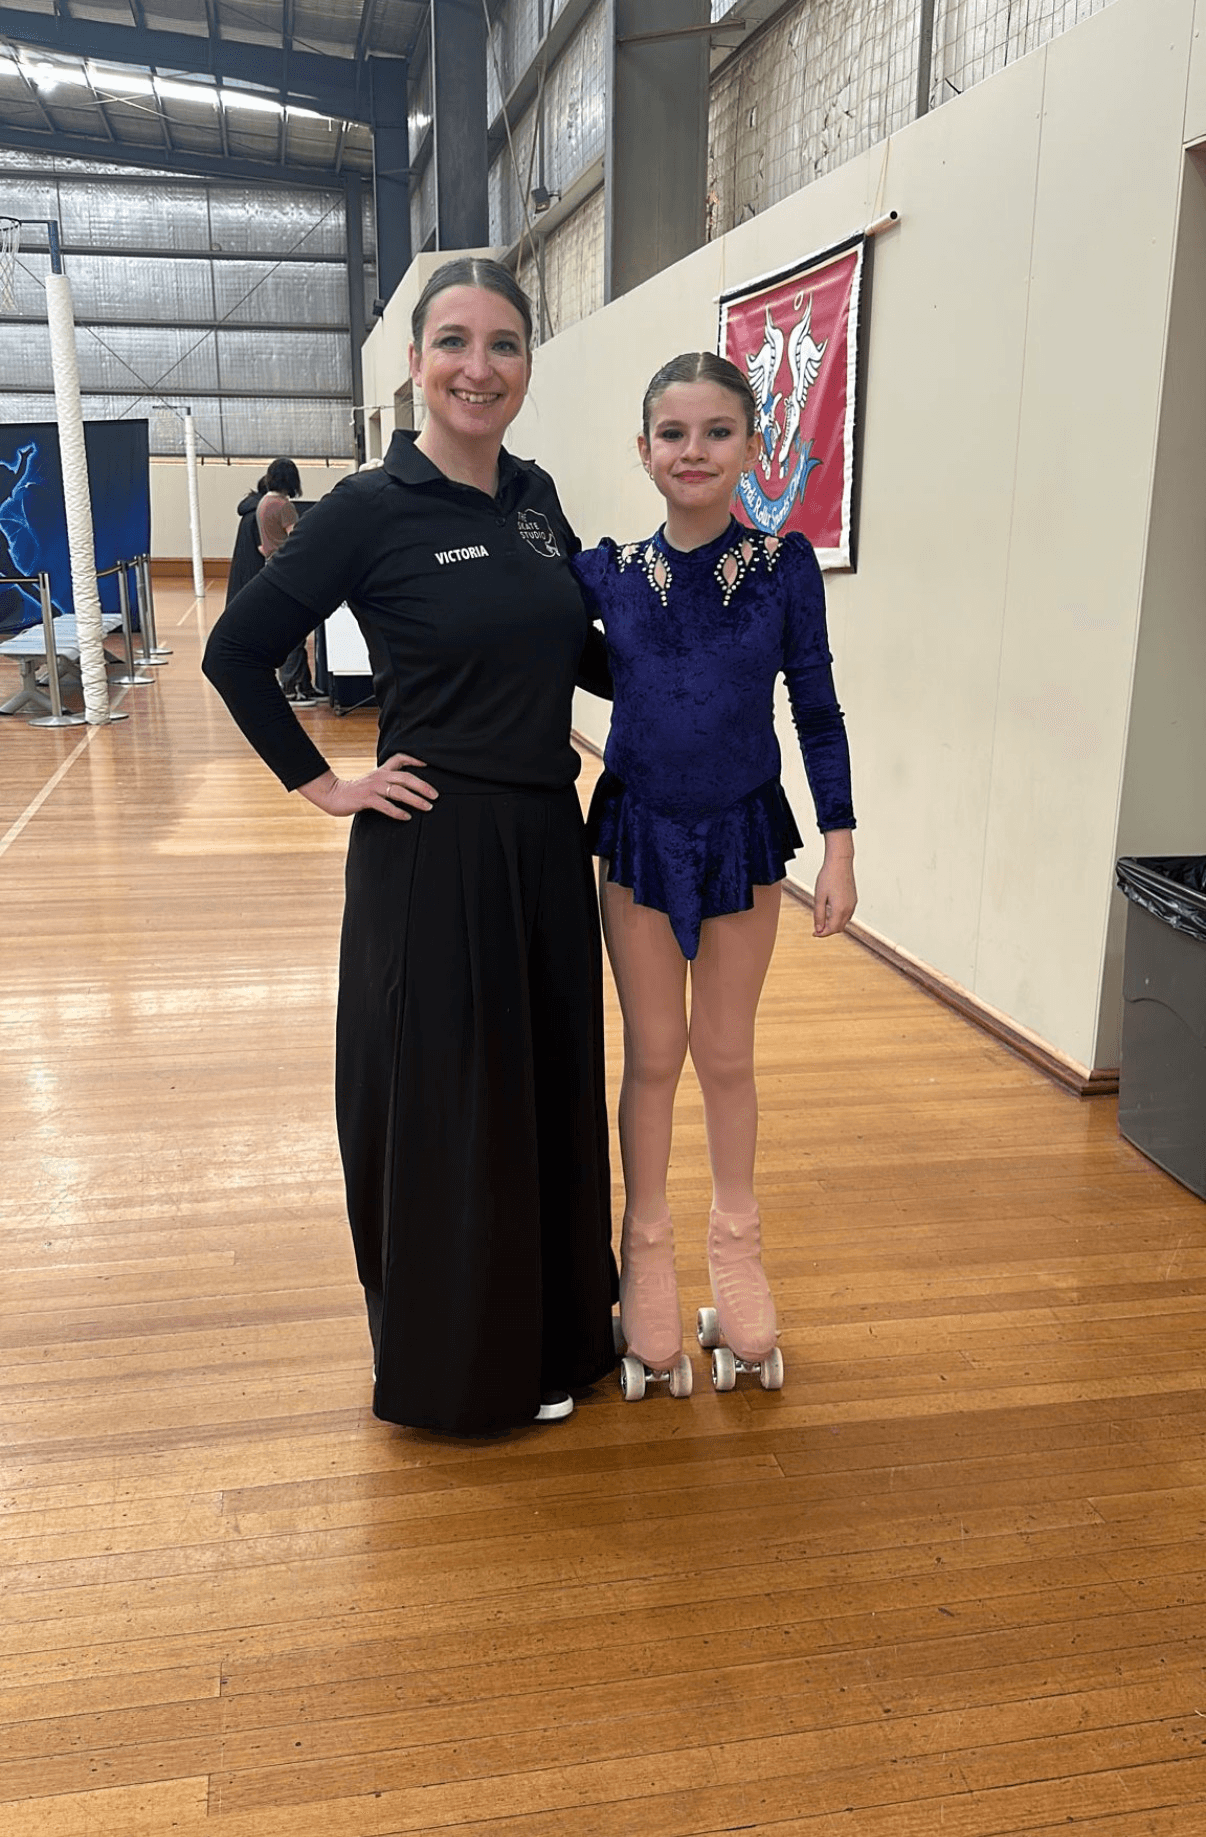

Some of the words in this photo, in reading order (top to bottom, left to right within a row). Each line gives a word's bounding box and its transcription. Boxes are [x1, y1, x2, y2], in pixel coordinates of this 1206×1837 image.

[518, 522, 540, 531] SKATE
[520, 531, 547, 540] STUDIO
[434, 545, 490, 565] VICTORIA
